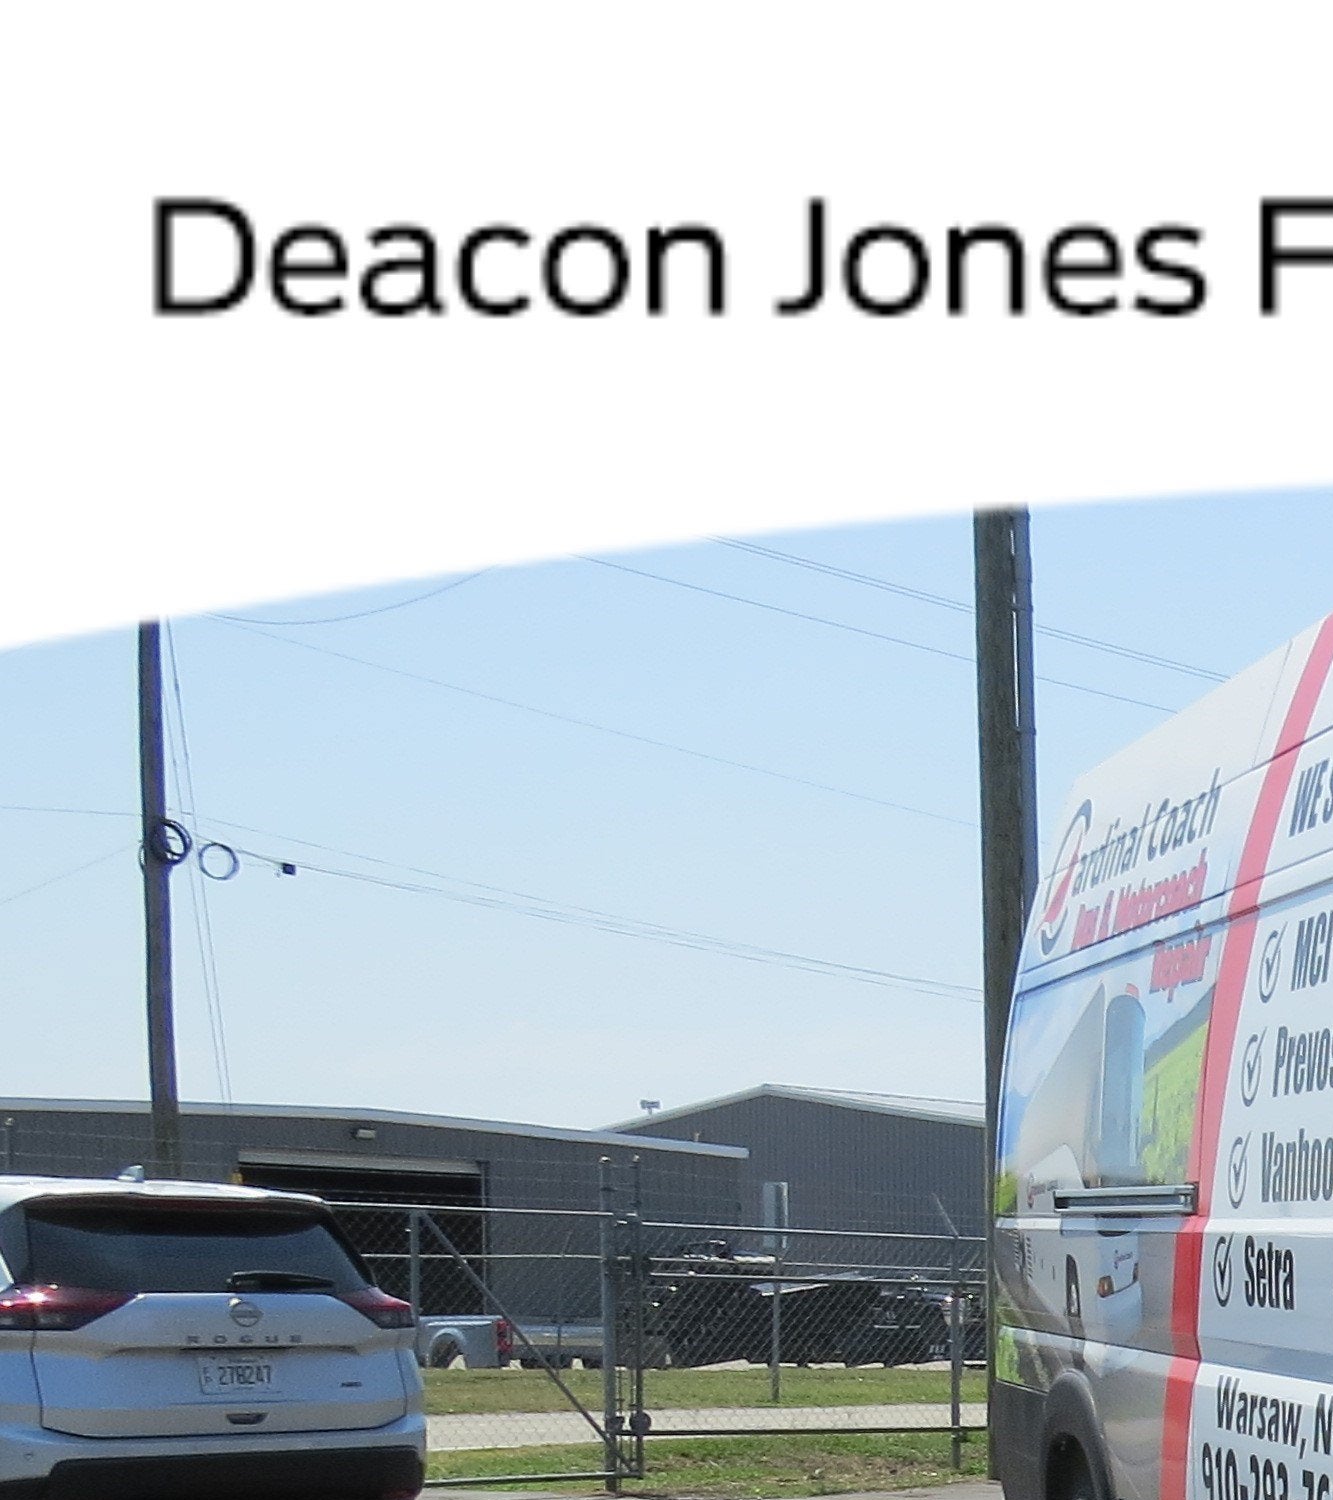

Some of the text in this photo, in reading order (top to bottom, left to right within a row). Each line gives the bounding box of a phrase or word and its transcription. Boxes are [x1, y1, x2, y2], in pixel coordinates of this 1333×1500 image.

[1147, 763, 1222, 863] Coach
[1288, 757, 1330, 838] WE
[1244, 1234, 1295, 1311] Setra
[1216, 1375, 1307, 1460] Warsaw,
